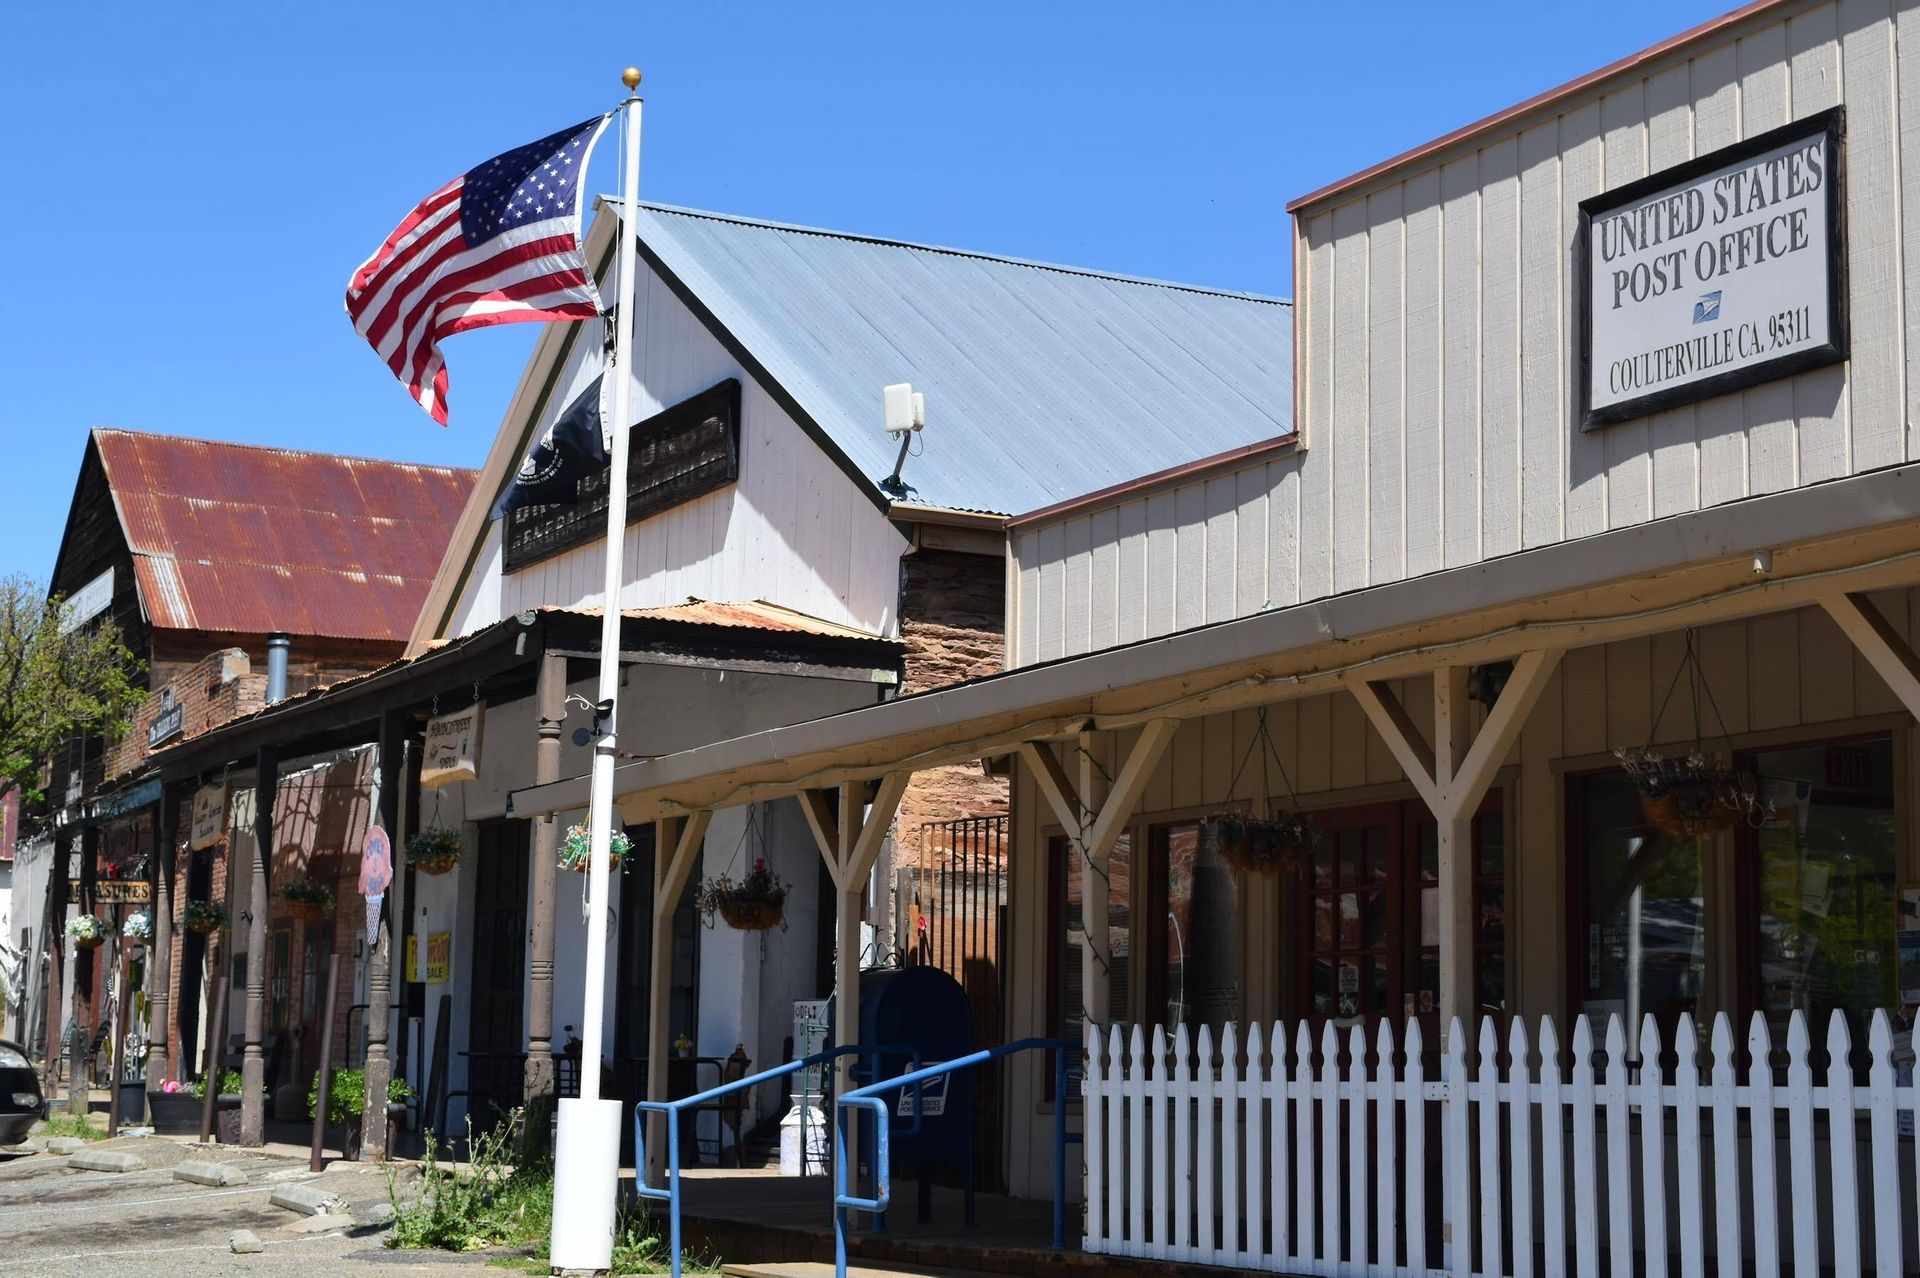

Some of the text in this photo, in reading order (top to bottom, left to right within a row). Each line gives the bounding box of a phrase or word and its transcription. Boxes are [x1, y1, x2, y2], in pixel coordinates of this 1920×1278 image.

[1600, 142, 1823, 263] UNITED STATES
[1611, 207, 1809, 310] POST OFFICE
[1609, 327, 1733, 394] COULTERVILLE
[1768, 304, 1811, 351] 95311
[68, 884, 148, 898] TASURES
